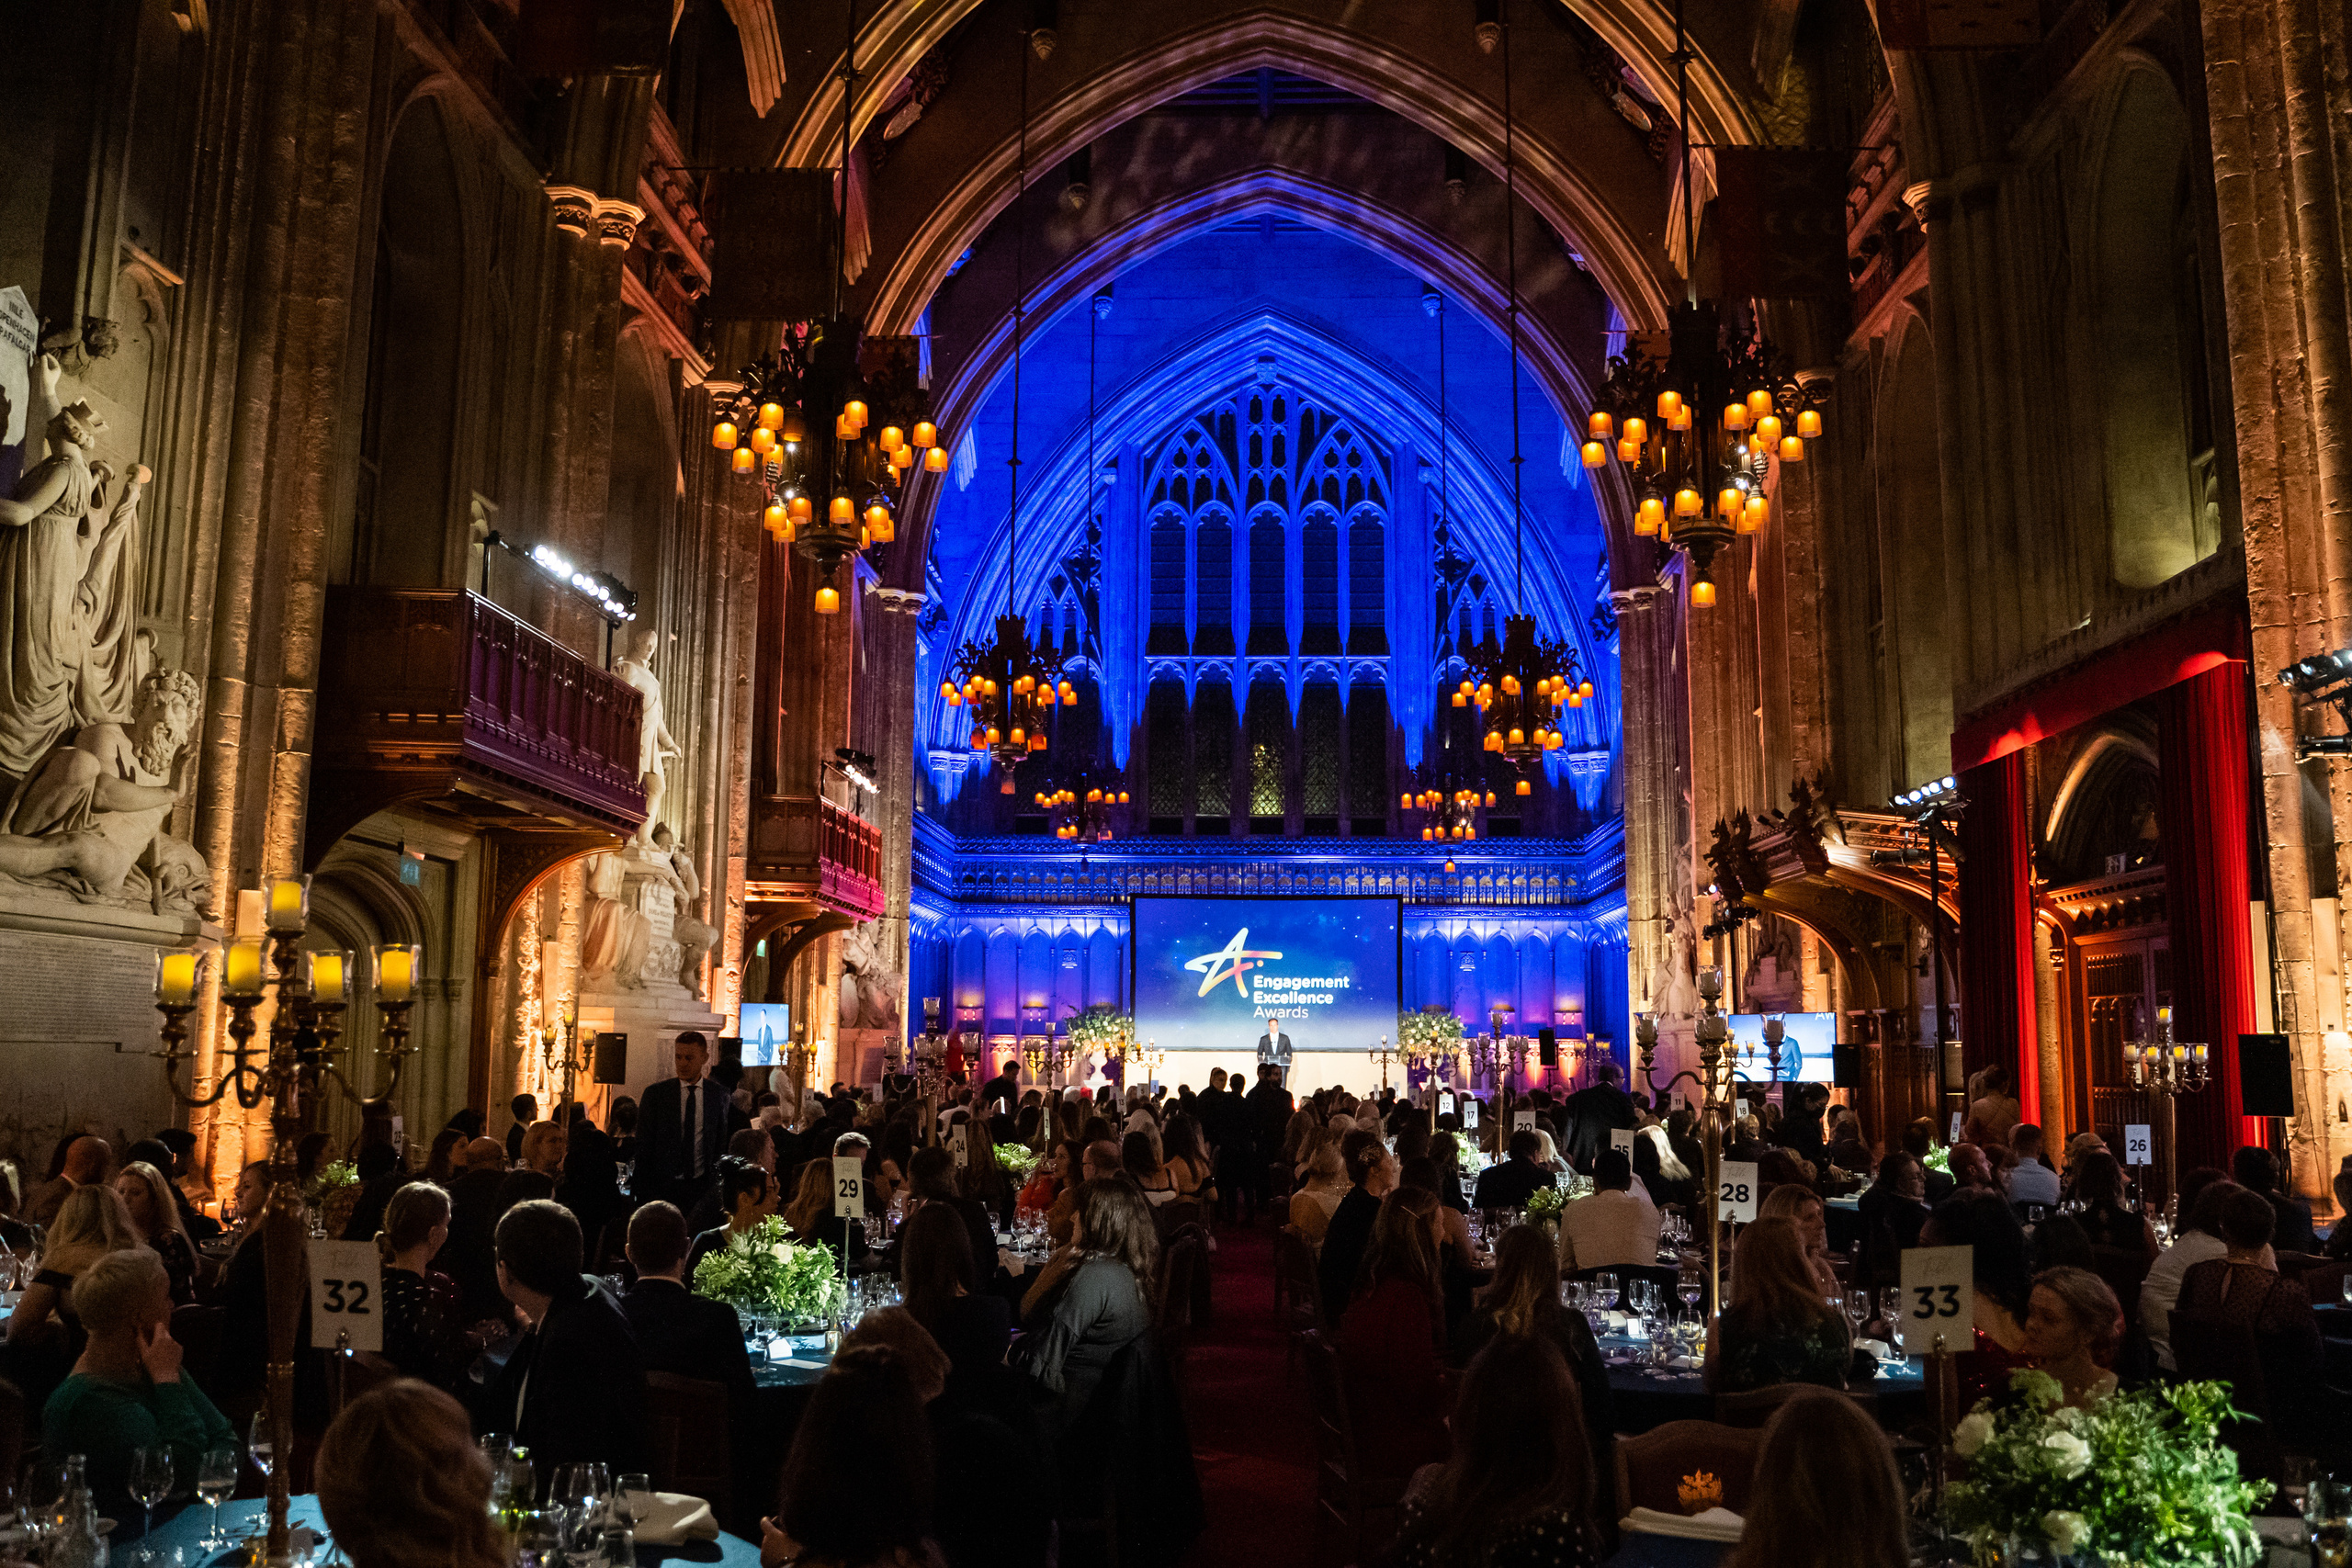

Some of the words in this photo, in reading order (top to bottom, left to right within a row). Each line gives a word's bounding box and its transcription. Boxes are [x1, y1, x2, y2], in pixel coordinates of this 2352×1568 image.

[1253, 975, 1350, 990] Engagement
[1253, 991, 1333, 1004] Excellence
[1253, 1006, 1309, 1019] Awards
[1467, 1111, 1475, 1120] 17
[1739, 1107, 1747, 1115] 18
[1517, 1122, 1532, 1132] 20
[394, 1131, 401, 1144] 23
[956, 1139, 965, 1153] 24
[2130, 1139, 2146, 1152] 26
[839, 1179, 858, 1198] 29
[1720, 1183, 1749, 1202] 28
[322, 1279, 370, 1314] 32
[1913, 1284, 1960, 1319] 33
